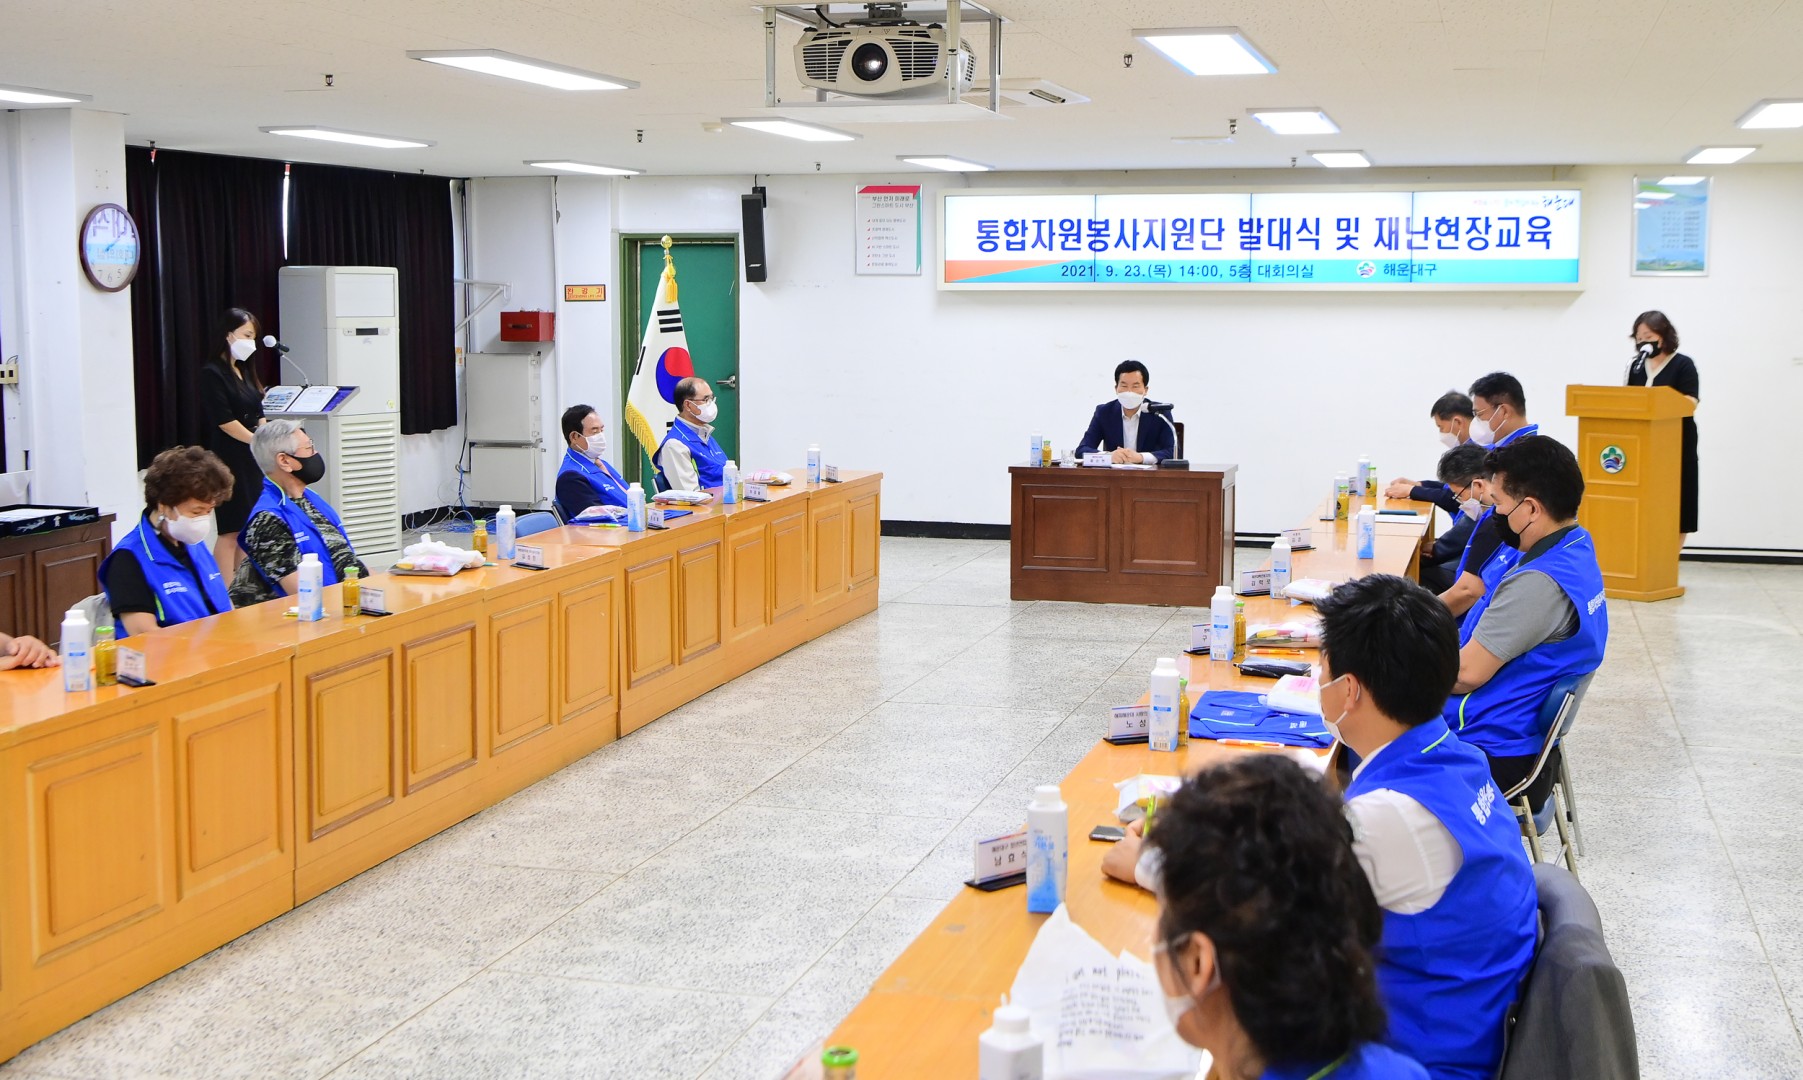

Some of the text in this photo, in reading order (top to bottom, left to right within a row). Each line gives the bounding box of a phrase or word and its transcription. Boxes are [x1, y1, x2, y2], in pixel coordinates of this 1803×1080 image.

[976, 215, 1552, 253] 통합자원봉사지원단 발대식 및 재난현장교육
[1061, 263, 1314, 280] 2021. 9. 23.(목) 14:00, 5층 대회의실
[1383, 262, 1438, 277] 해운대구
